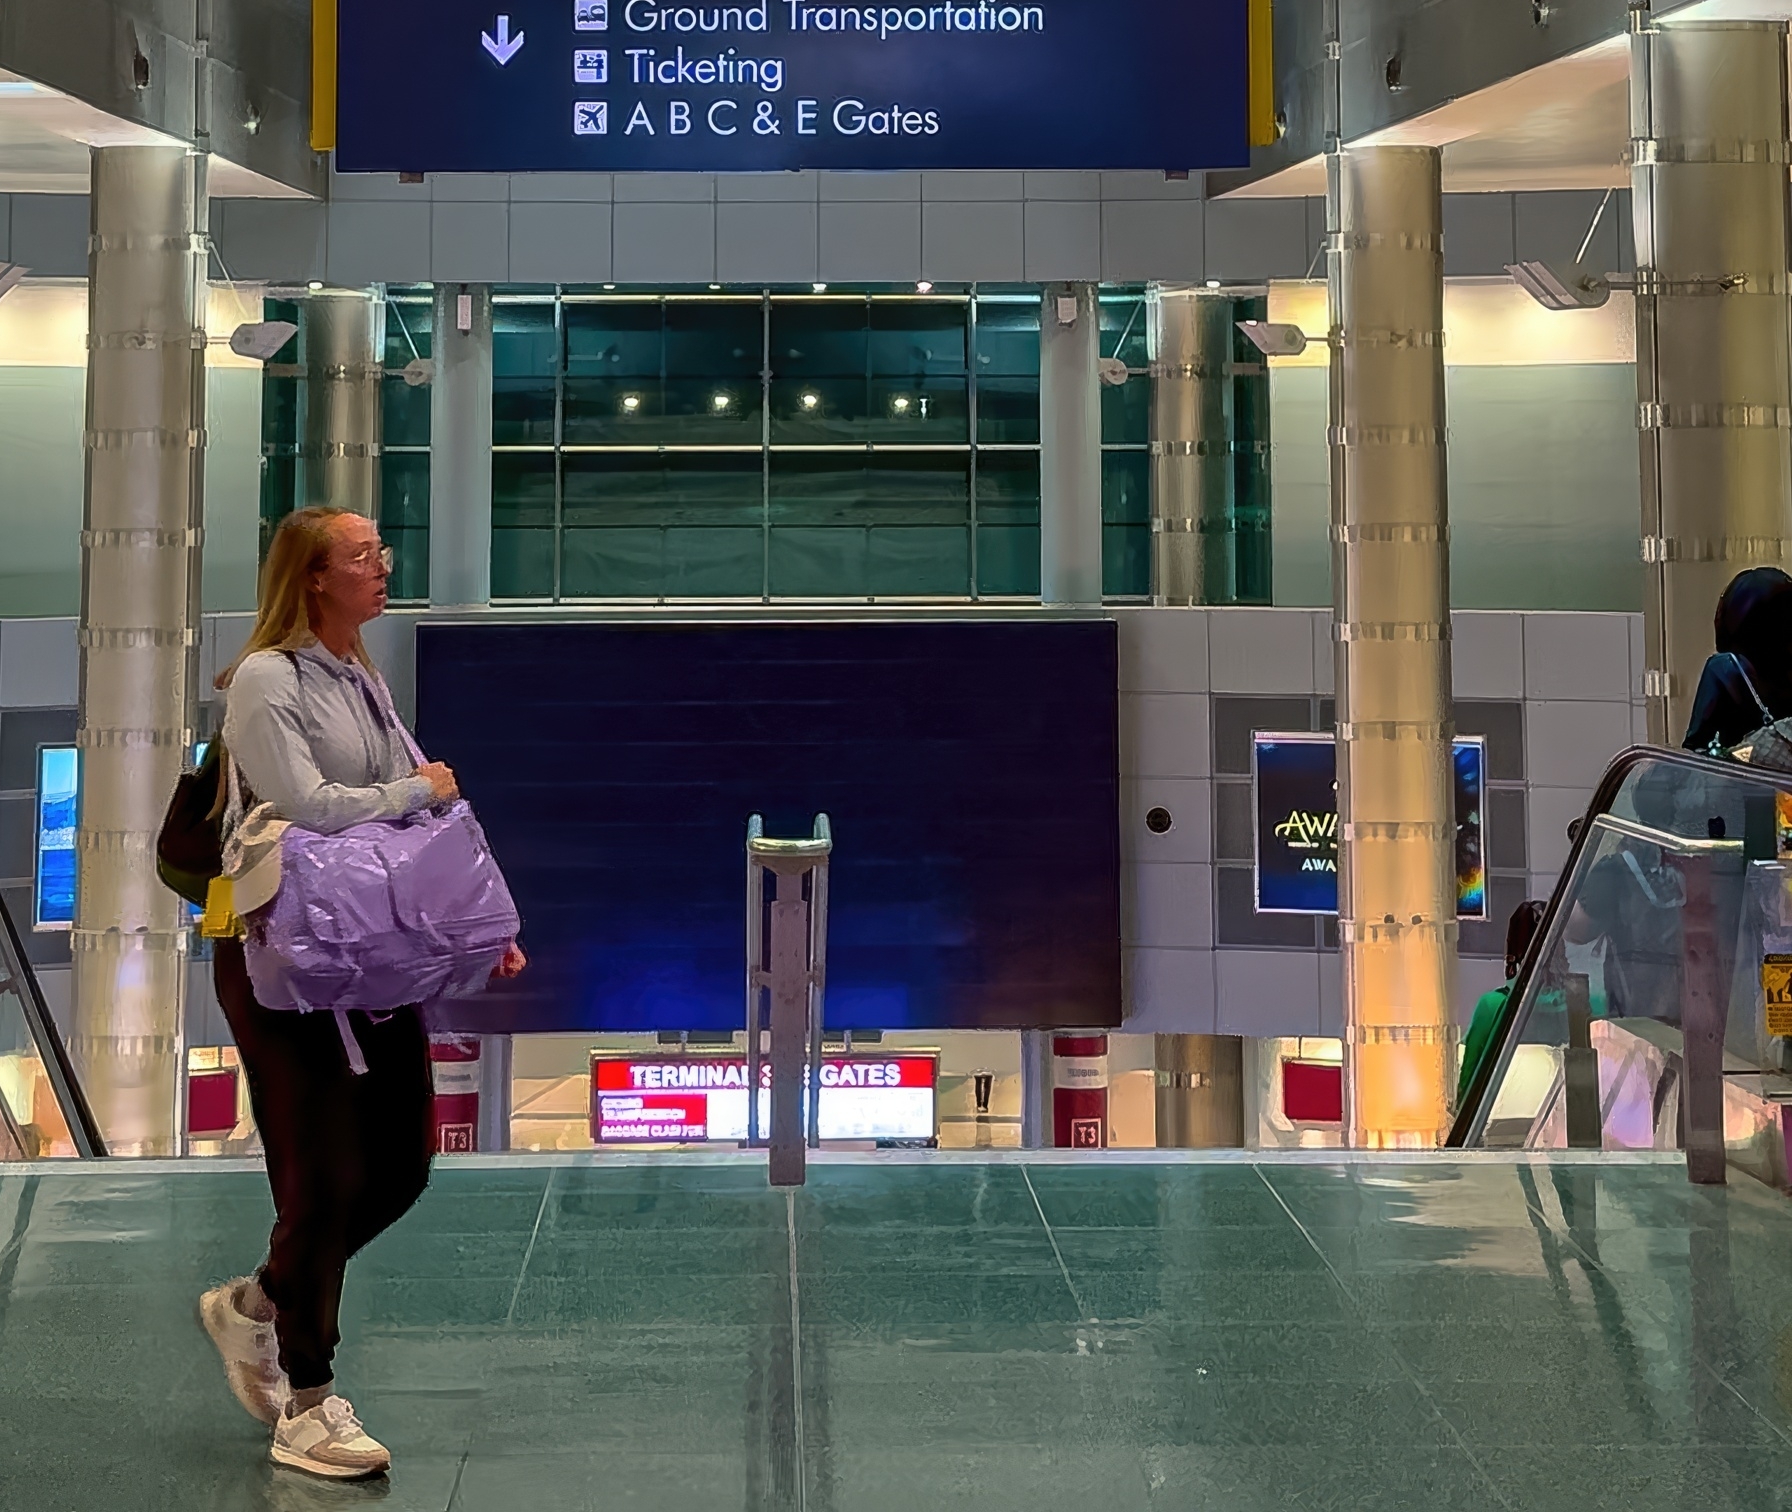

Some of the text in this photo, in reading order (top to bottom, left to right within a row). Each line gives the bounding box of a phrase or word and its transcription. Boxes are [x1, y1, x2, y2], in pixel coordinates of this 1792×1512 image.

[623, 45, 784, 93] Ticketing
[624, 99, 940, 136] A B C & E Gates
[819, 1063, 902, 1086] GATES
